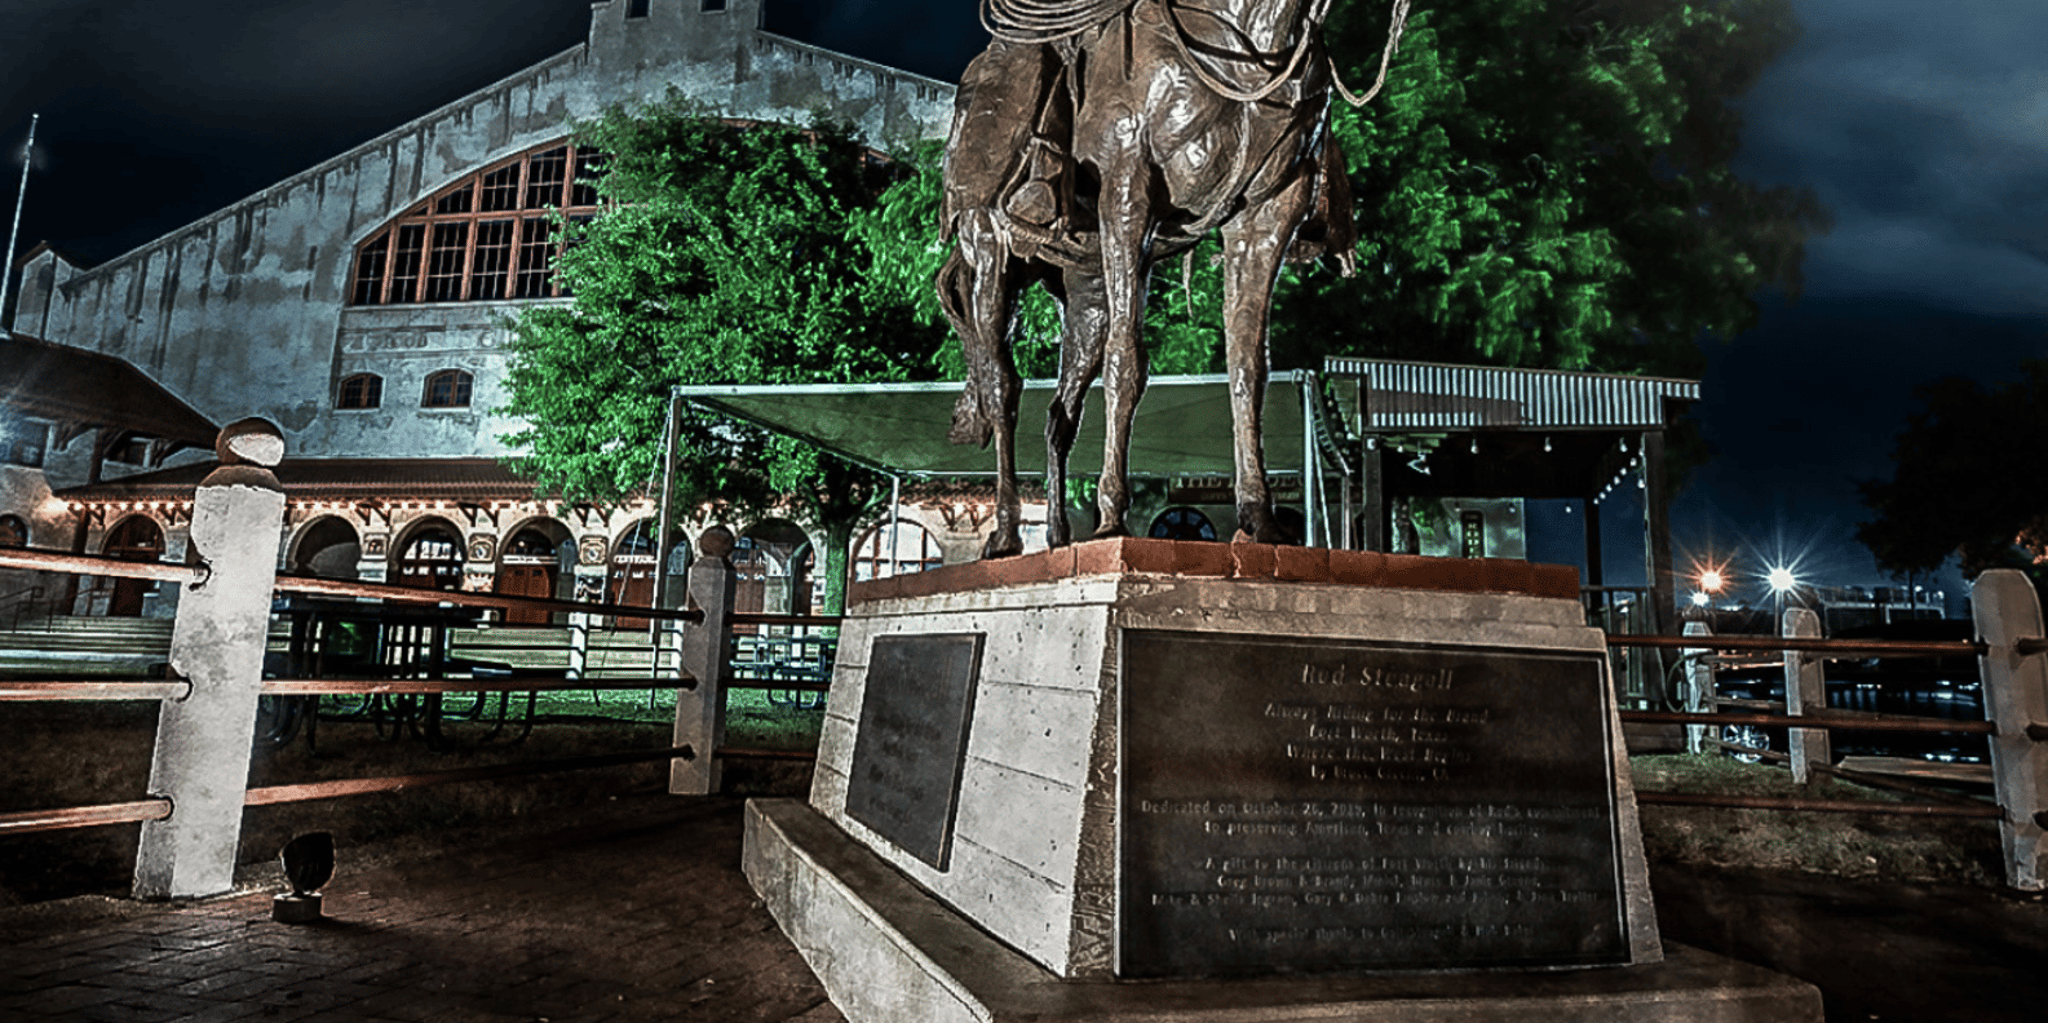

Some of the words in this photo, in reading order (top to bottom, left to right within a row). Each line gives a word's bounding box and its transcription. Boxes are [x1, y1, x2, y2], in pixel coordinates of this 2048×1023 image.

[1175, 476, 1222, 489] THE
[1360, 667, 1453, 692] Steagall
[1141, 800, 1210, 814] Dedicated
[1218, 804, 1237, 814] on
[1242, 801, 1296, 815] October
[1205, 821, 1221, 834] to
[1227, 823, 1298, 837] preserving
